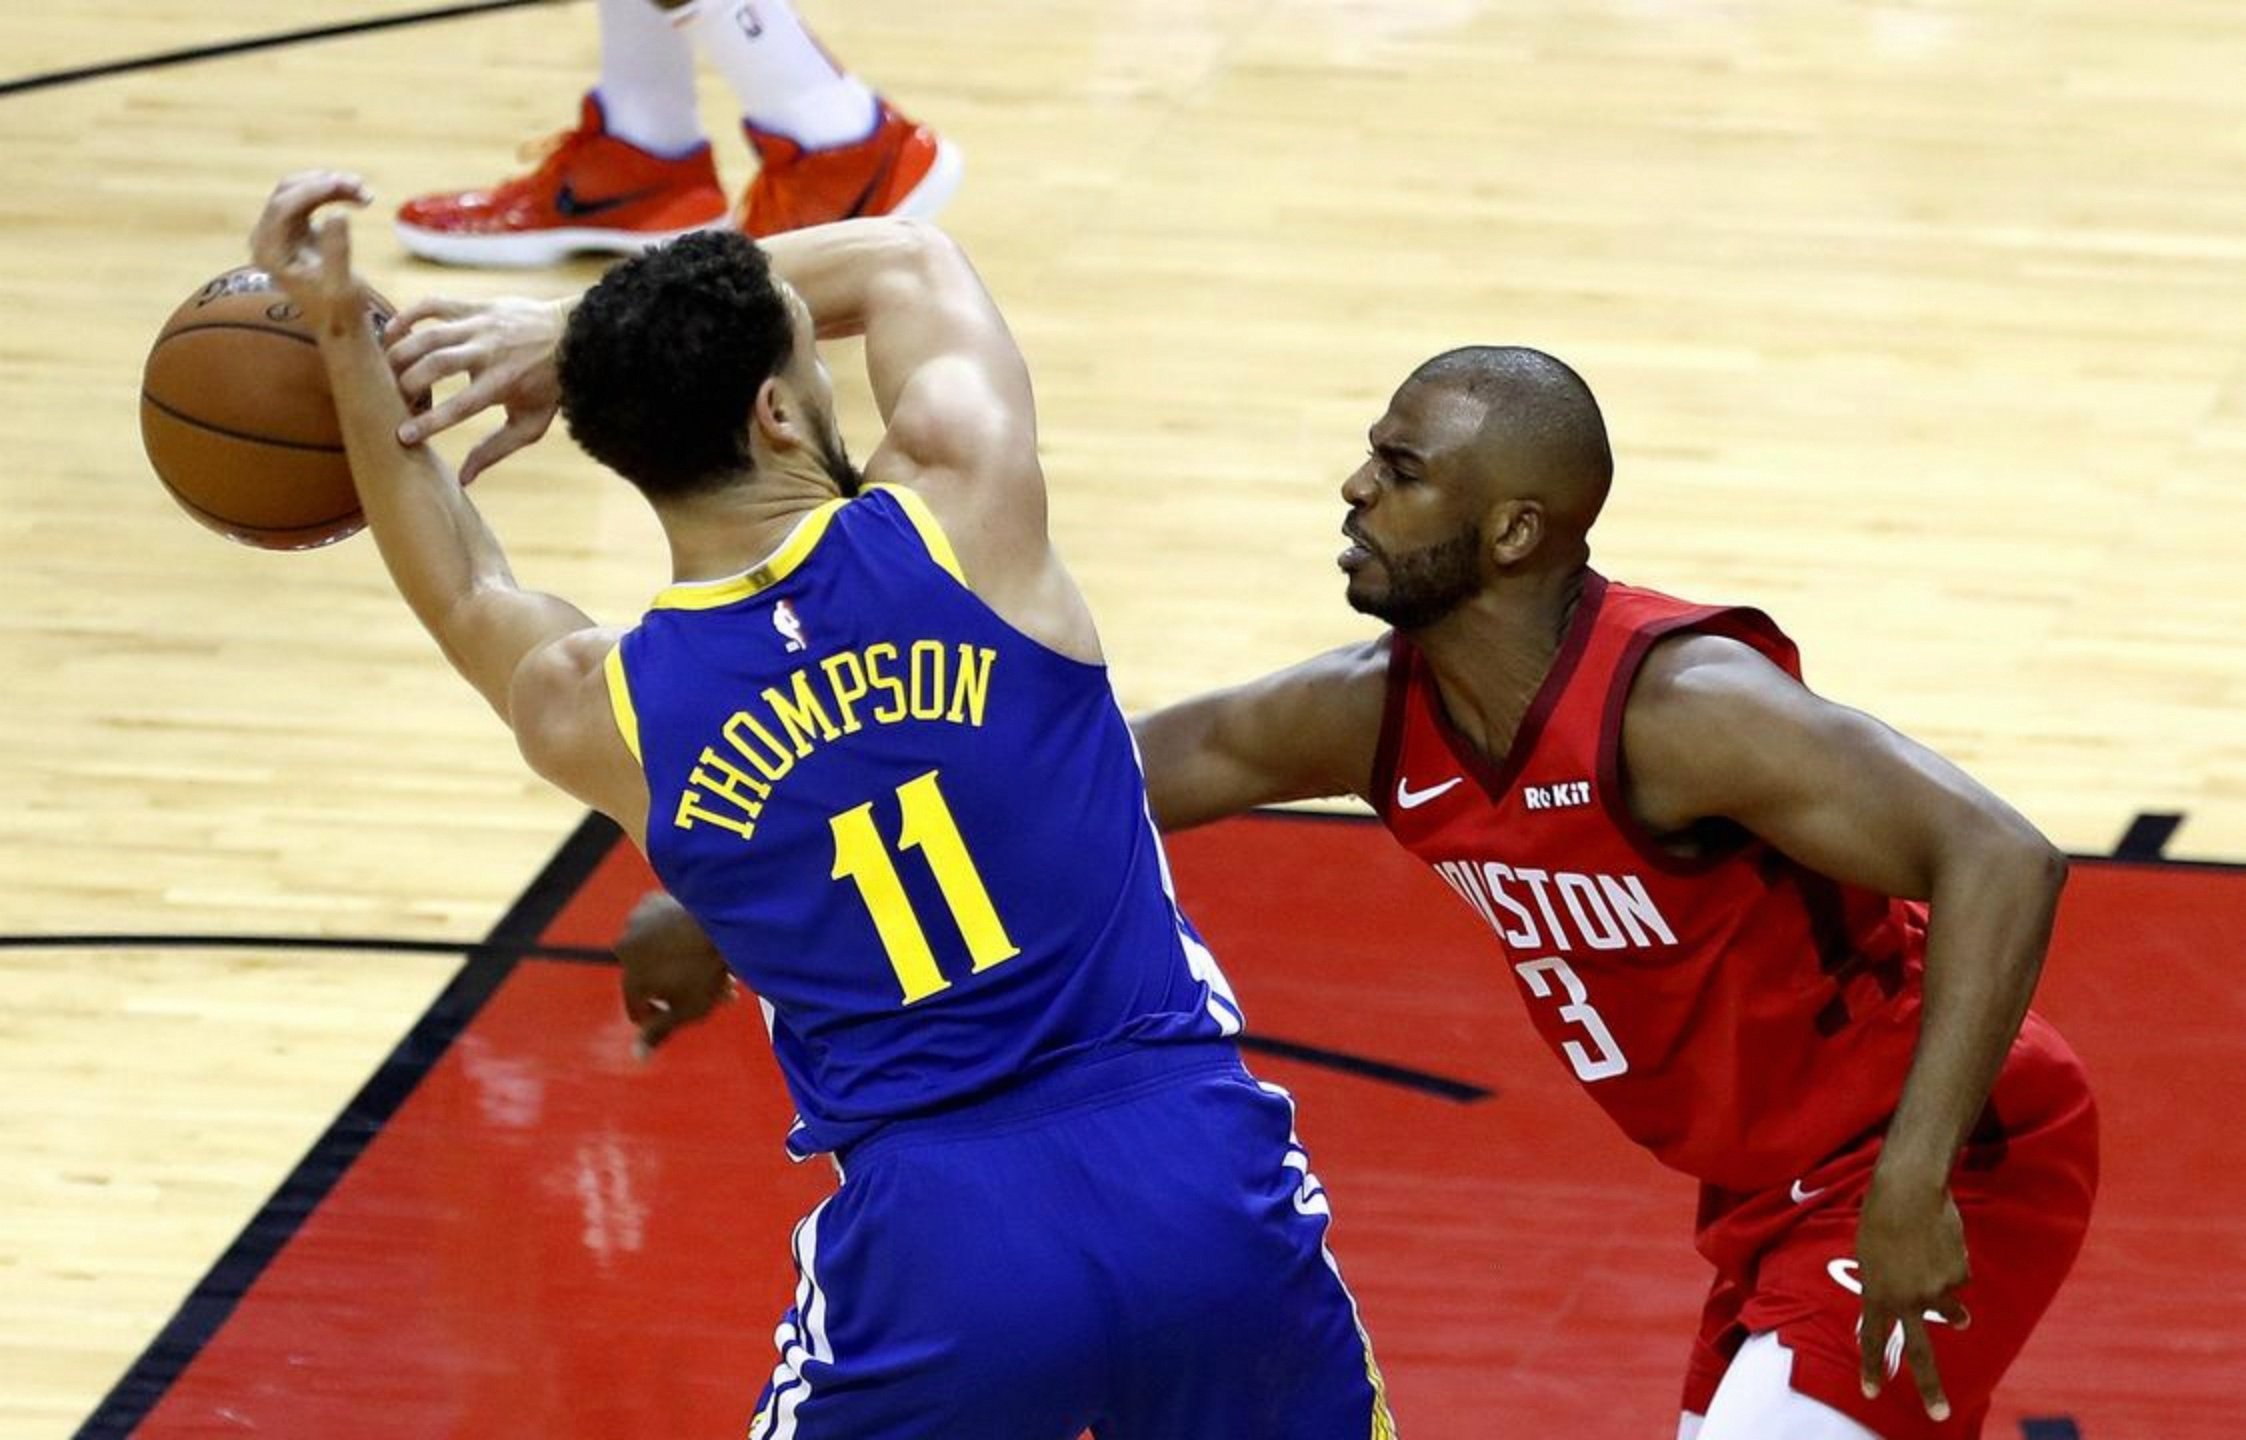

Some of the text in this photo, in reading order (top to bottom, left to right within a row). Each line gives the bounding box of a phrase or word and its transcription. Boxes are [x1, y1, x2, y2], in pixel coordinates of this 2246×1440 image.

[675, 640, 996, 840] THOMPSON
[829, 769, 1021, 1006] 11
[1515, 956, 1629, 1082] 3
